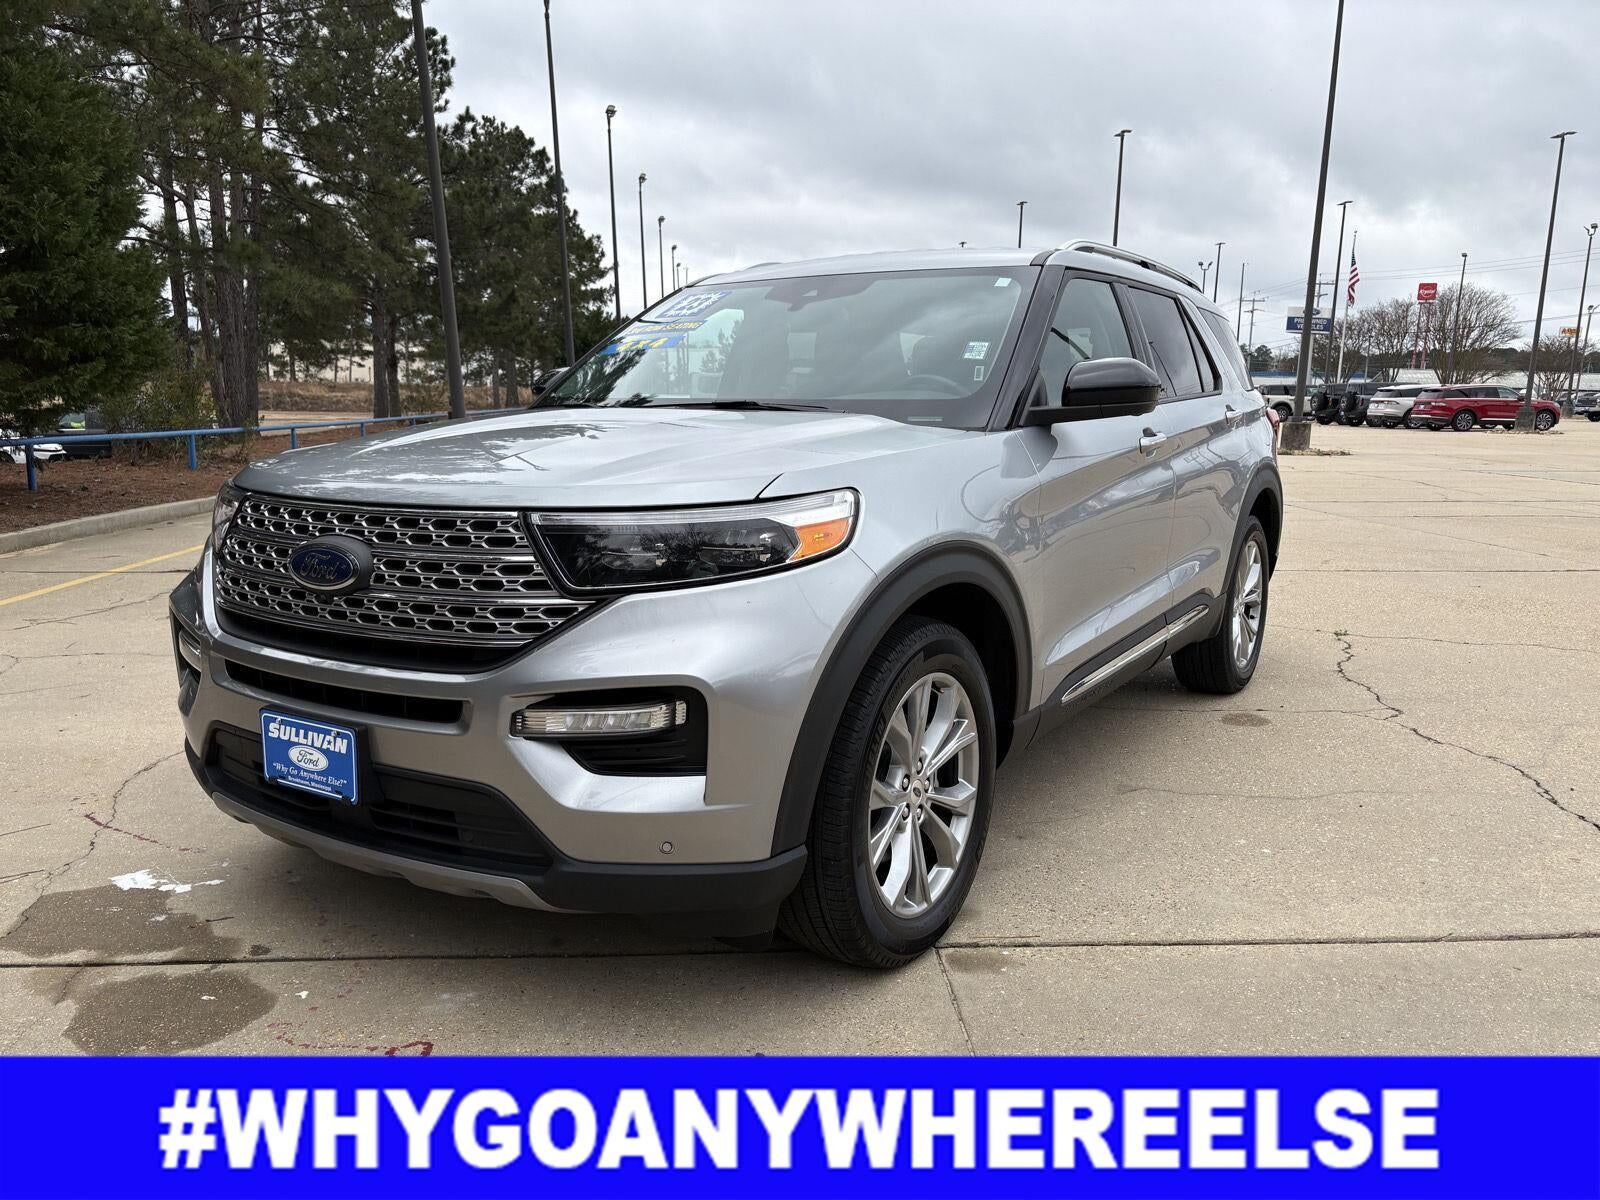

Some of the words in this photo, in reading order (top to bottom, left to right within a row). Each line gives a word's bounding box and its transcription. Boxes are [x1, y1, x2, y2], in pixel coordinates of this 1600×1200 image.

[268, 722, 348, 754] SULLIVAN
[296, 749, 320, 768] Ford
[289, 766, 298, 776] Go
[299, 768, 327, 783] Anywhere
